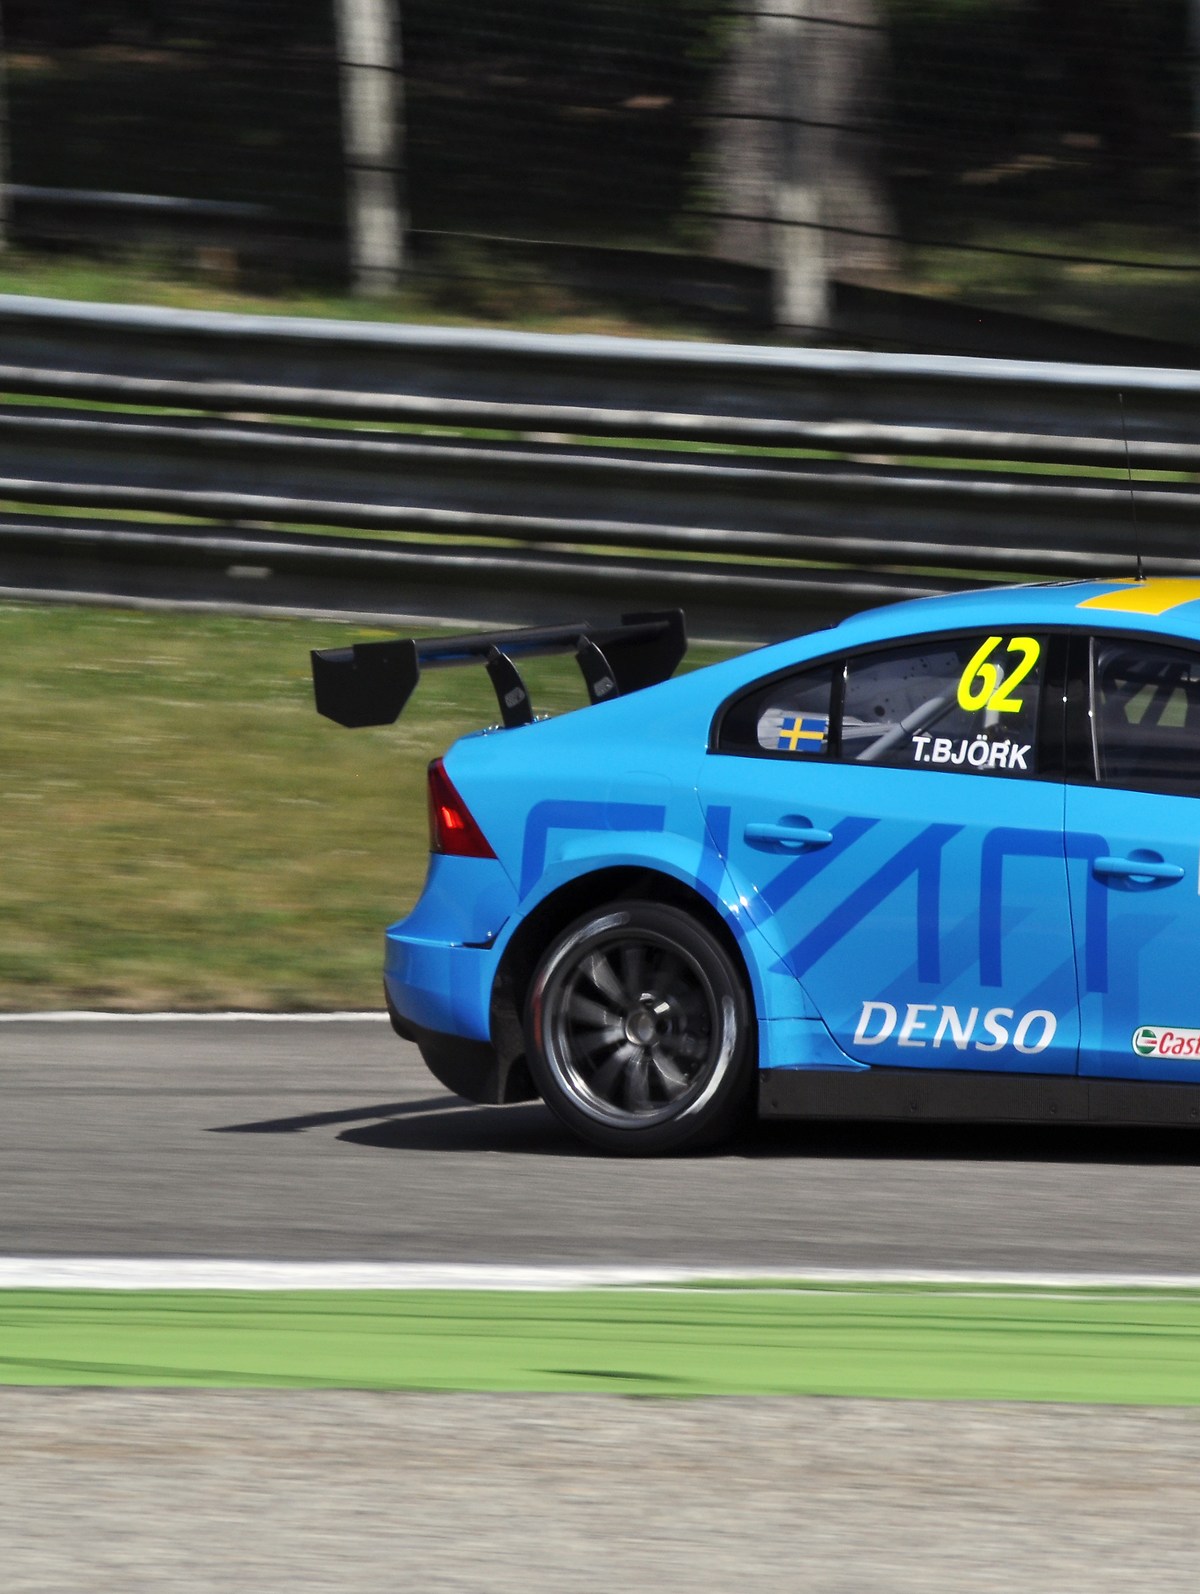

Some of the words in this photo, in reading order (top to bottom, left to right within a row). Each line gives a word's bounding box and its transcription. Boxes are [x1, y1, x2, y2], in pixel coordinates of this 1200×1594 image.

[956, 636, 1040, 714] 62
[912, 734, 1032, 770] T.BJÖRK
[853, 1001, 1058, 1054] DENSO
